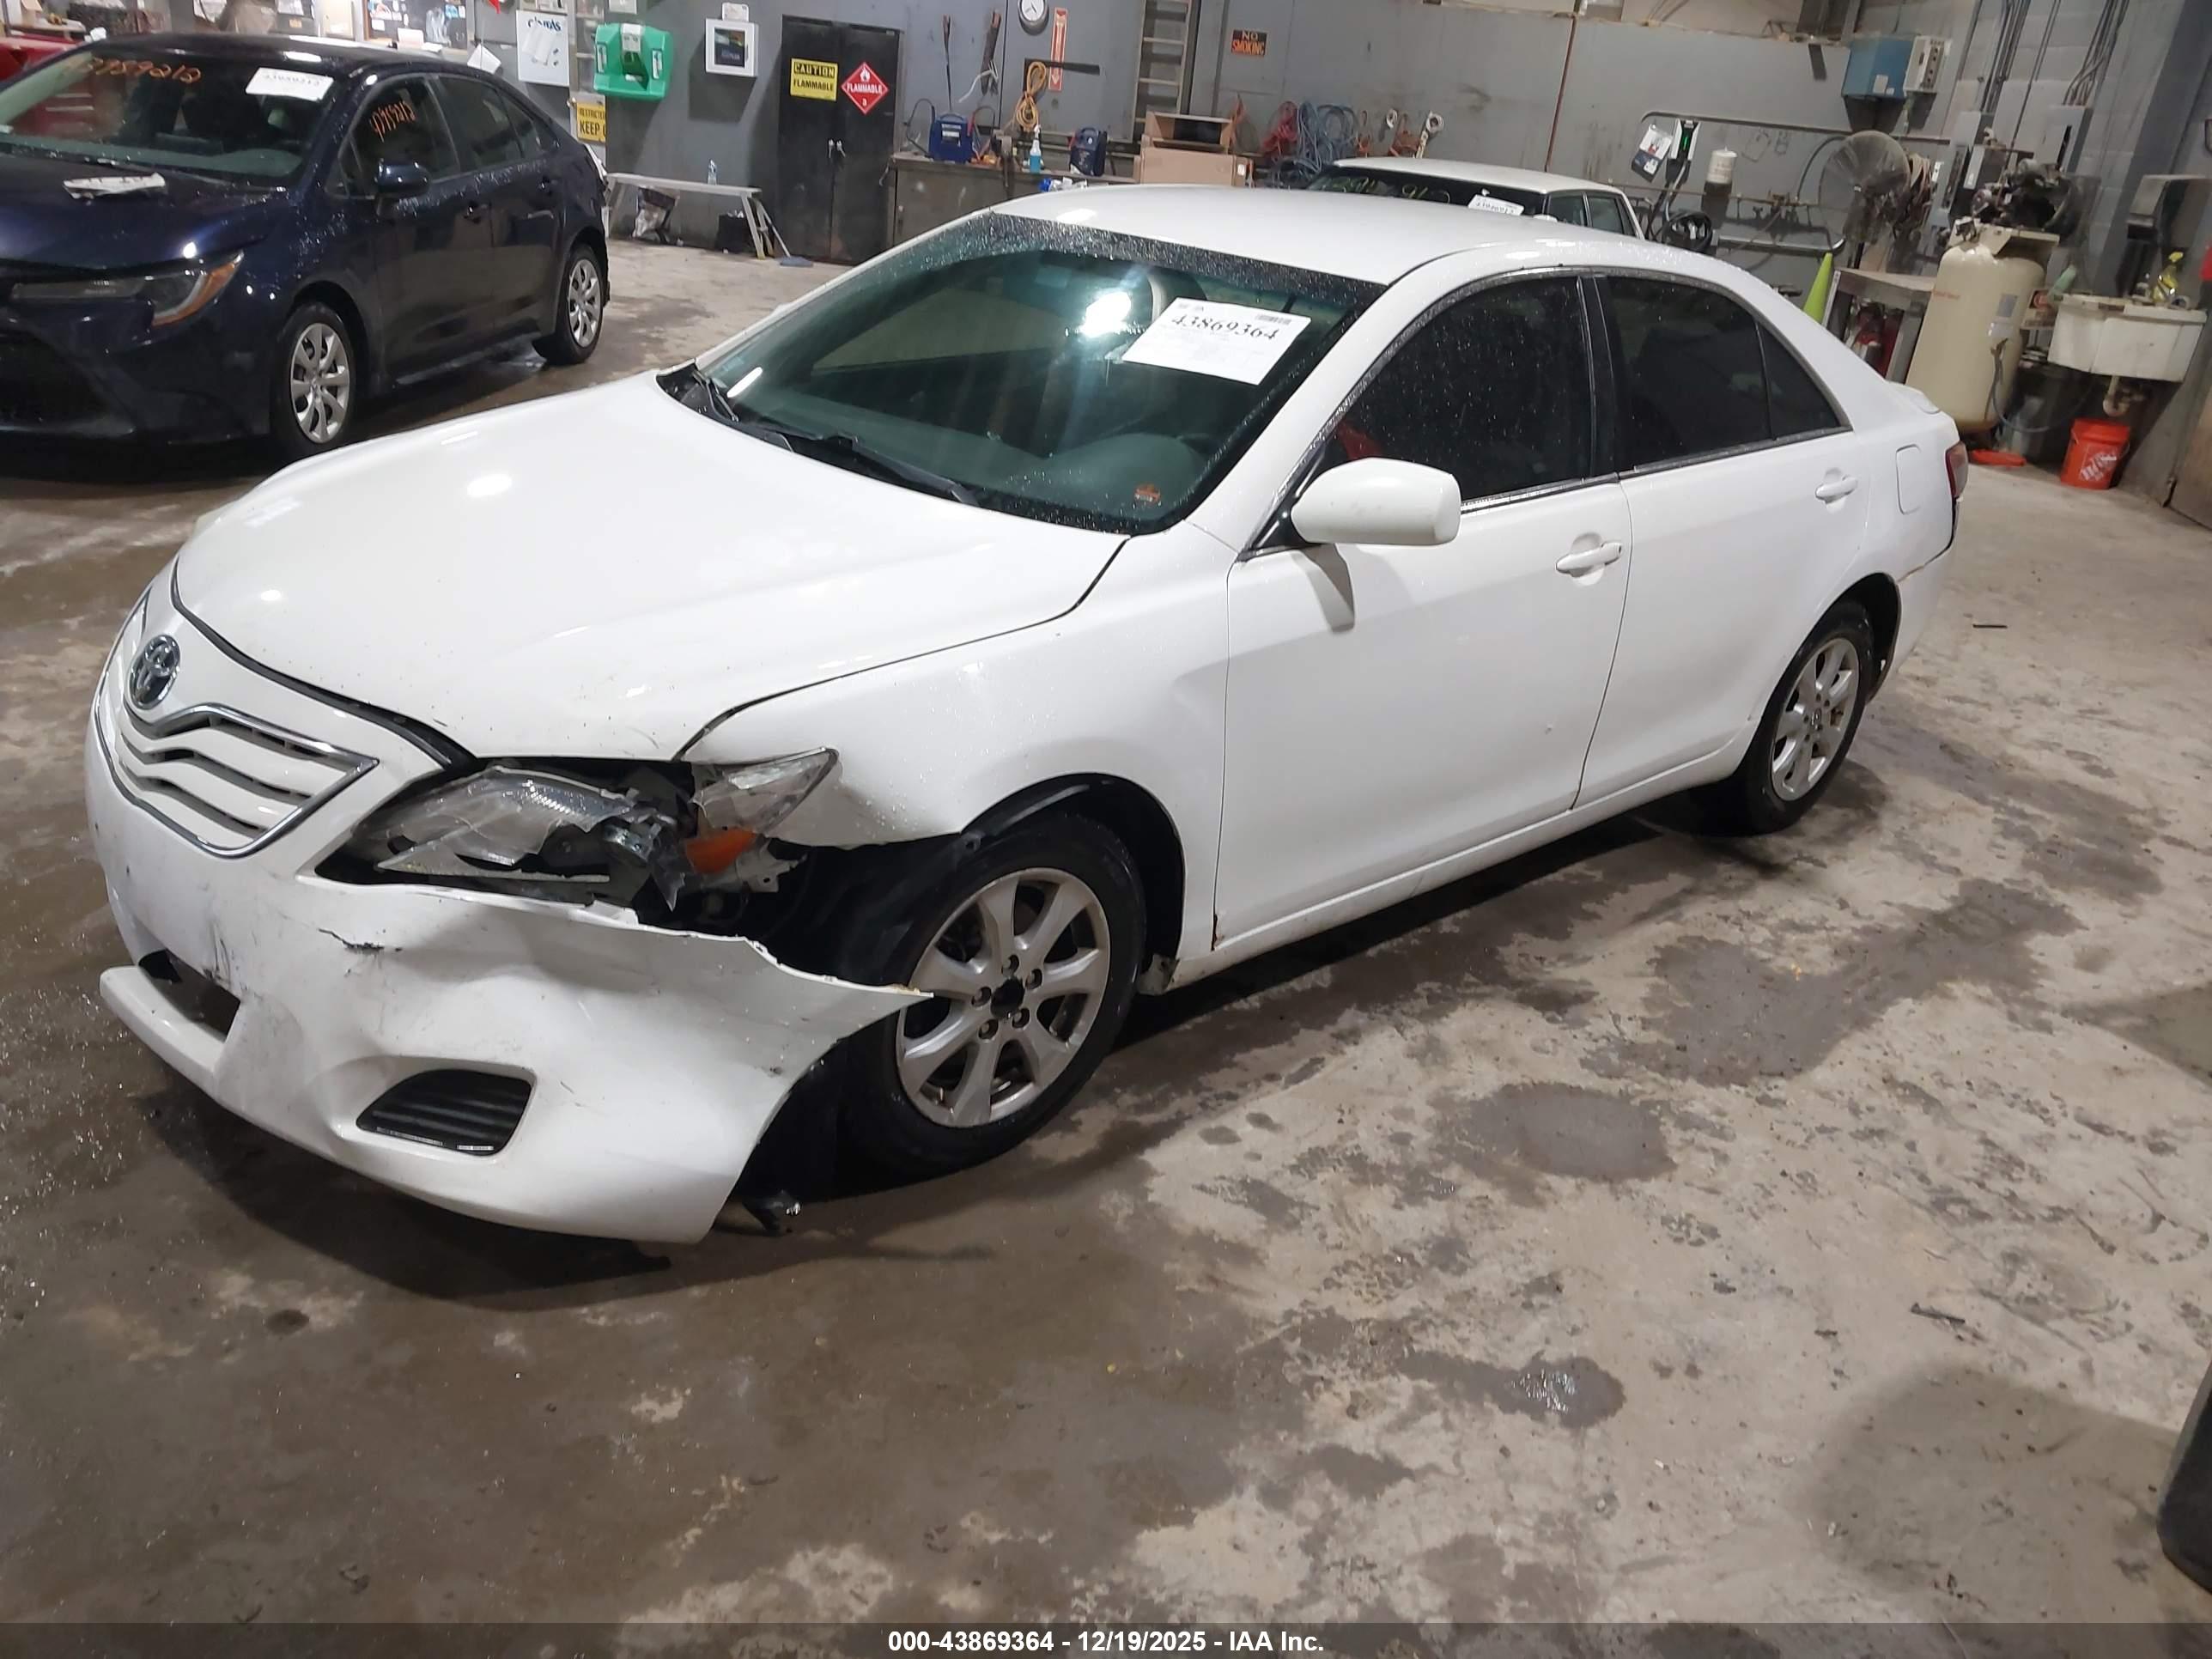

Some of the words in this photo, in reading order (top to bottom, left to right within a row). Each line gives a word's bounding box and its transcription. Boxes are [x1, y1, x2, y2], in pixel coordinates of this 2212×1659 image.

[1242, 30, 1258, 40] NO
[1232, 40, 1265, 55] SMOKING
[795, 63, 835, 78] CAUTION
[793, 78, 834, 91] FLAMMABLE
[846, 82, 883, 94] FLAMMABLE
[579, 120, 600, 136] KEEP
[1171, 313, 1280, 341] 43869364
